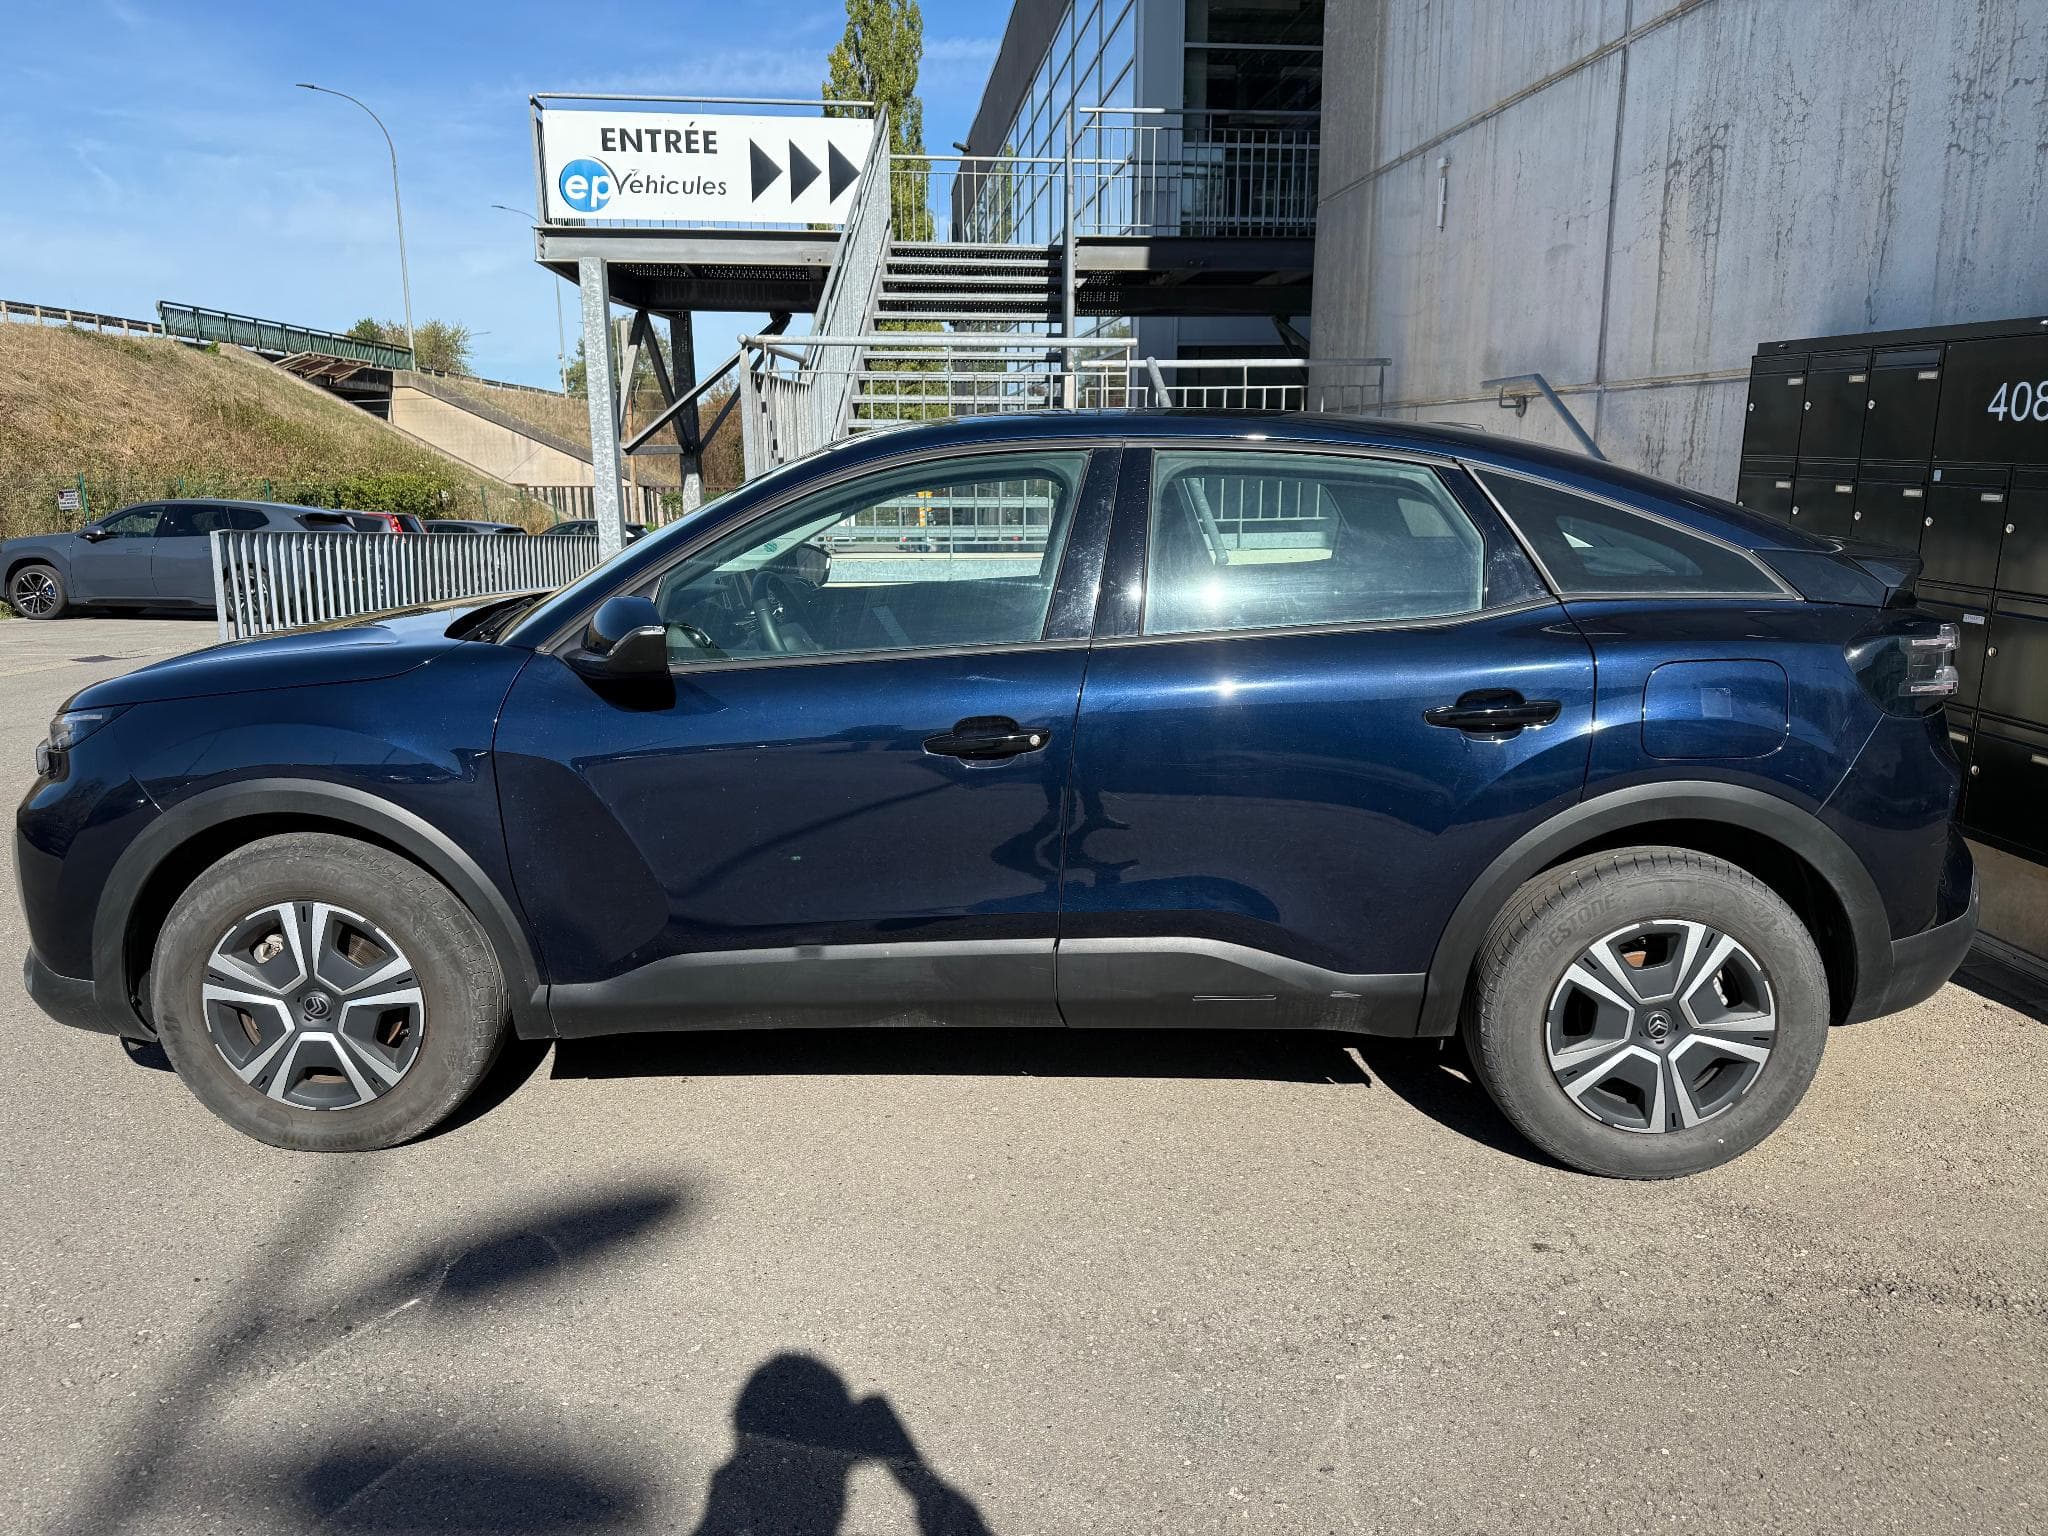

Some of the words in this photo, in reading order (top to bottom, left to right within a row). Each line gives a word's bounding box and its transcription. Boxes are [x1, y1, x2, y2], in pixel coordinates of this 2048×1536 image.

[600, 122, 718, 154] ENTRÉE
[564, 174, 612, 208] ep
[1987, 381, 2048, 421] 408
